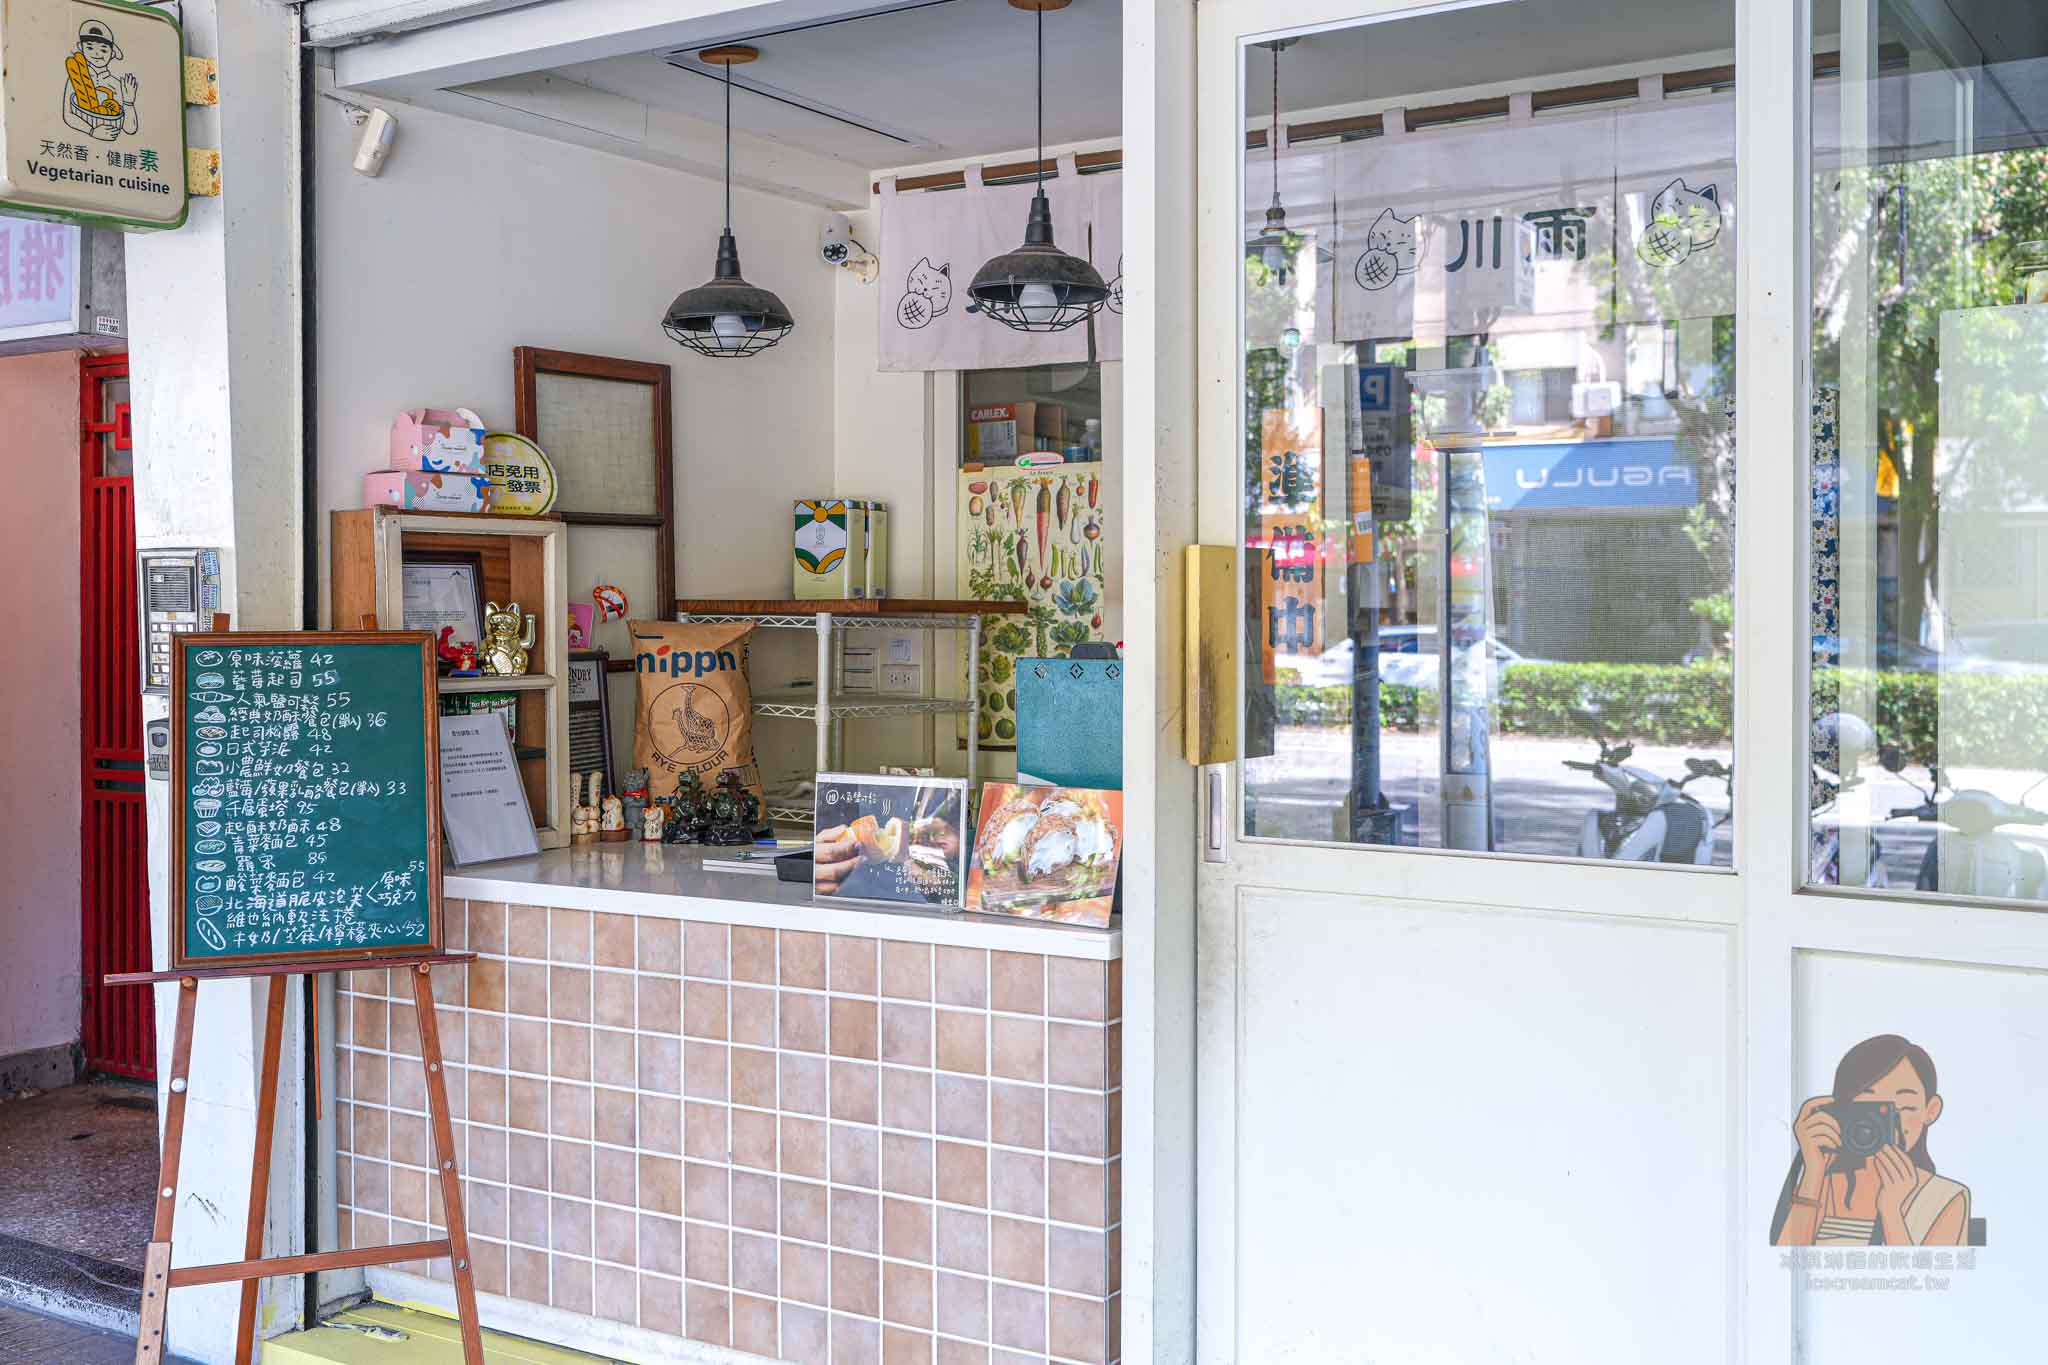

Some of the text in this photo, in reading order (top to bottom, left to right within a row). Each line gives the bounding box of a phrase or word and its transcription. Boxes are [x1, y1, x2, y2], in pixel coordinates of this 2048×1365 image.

[27, 159, 171, 195] Vegetarian cuisine
[228, 651, 335, 670] 原味菠蘿 42
[637, 645, 738, 678] nippn
[311, 669, 338, 688] 55
[569, 667, 592, 681] NDRY
[327, 691, 351, 708] 55
[366, 711, 388, 728] 36
[307, 728, 332, 742] 48
[226, 740, 333, 757] 日式芋泥 42
[332, 762, 350, 775] 32
[651, 751, 677, 774] RYE
[387, 781, 407, 797] 33
[296, 799, 320, 815] 95
[316, 817, 342, 832] 48
[305, 833, 329, 848] 45
[307, 851, 328, 865] 85
[407, 860, 425, 872] 55
[312, 870, 336, 884] 42
[380, 870, 412, 890] 原味
[225, 885, 365, 912] 北海道脆皮泡芙
[376, 889, 417, 907] 巧克力
